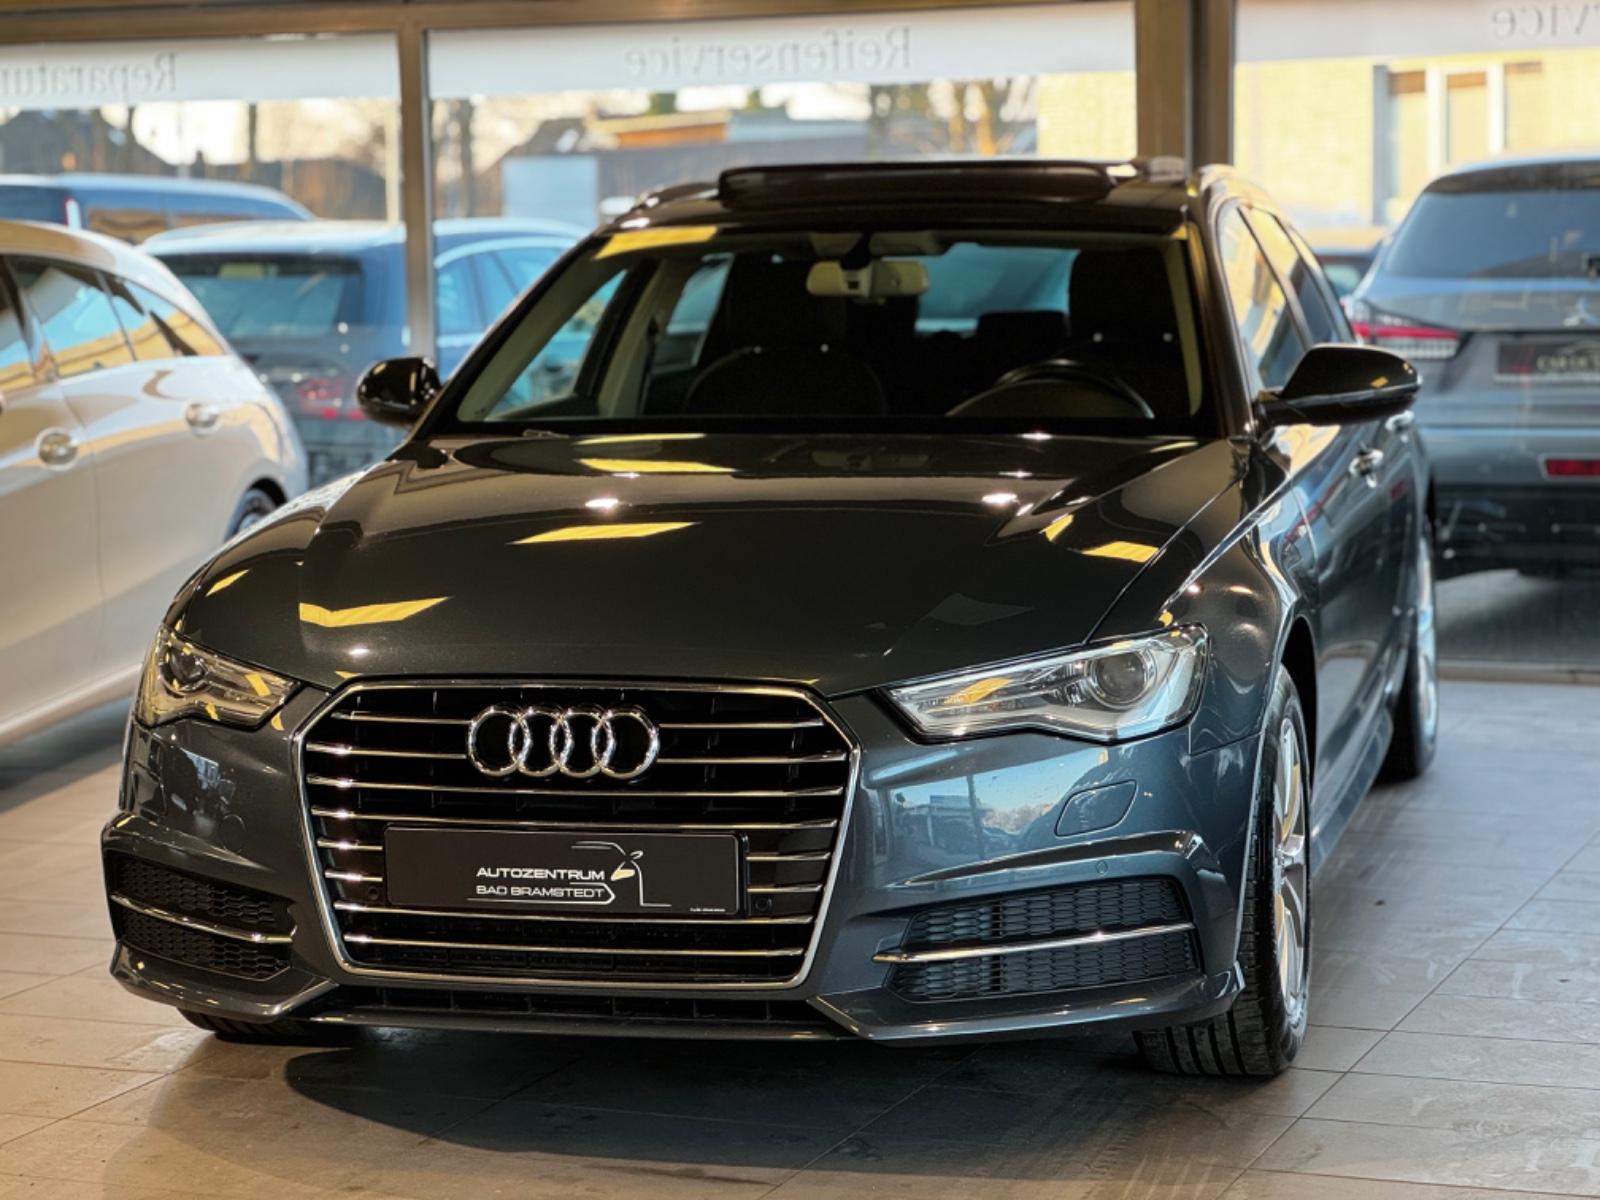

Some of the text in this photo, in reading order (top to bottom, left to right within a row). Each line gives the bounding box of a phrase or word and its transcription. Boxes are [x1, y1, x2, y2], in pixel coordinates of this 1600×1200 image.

[476, 867, 605, 881] AUTOZENTRUM
[476, 884, 605, 899] BAD BRAMSTEDT
